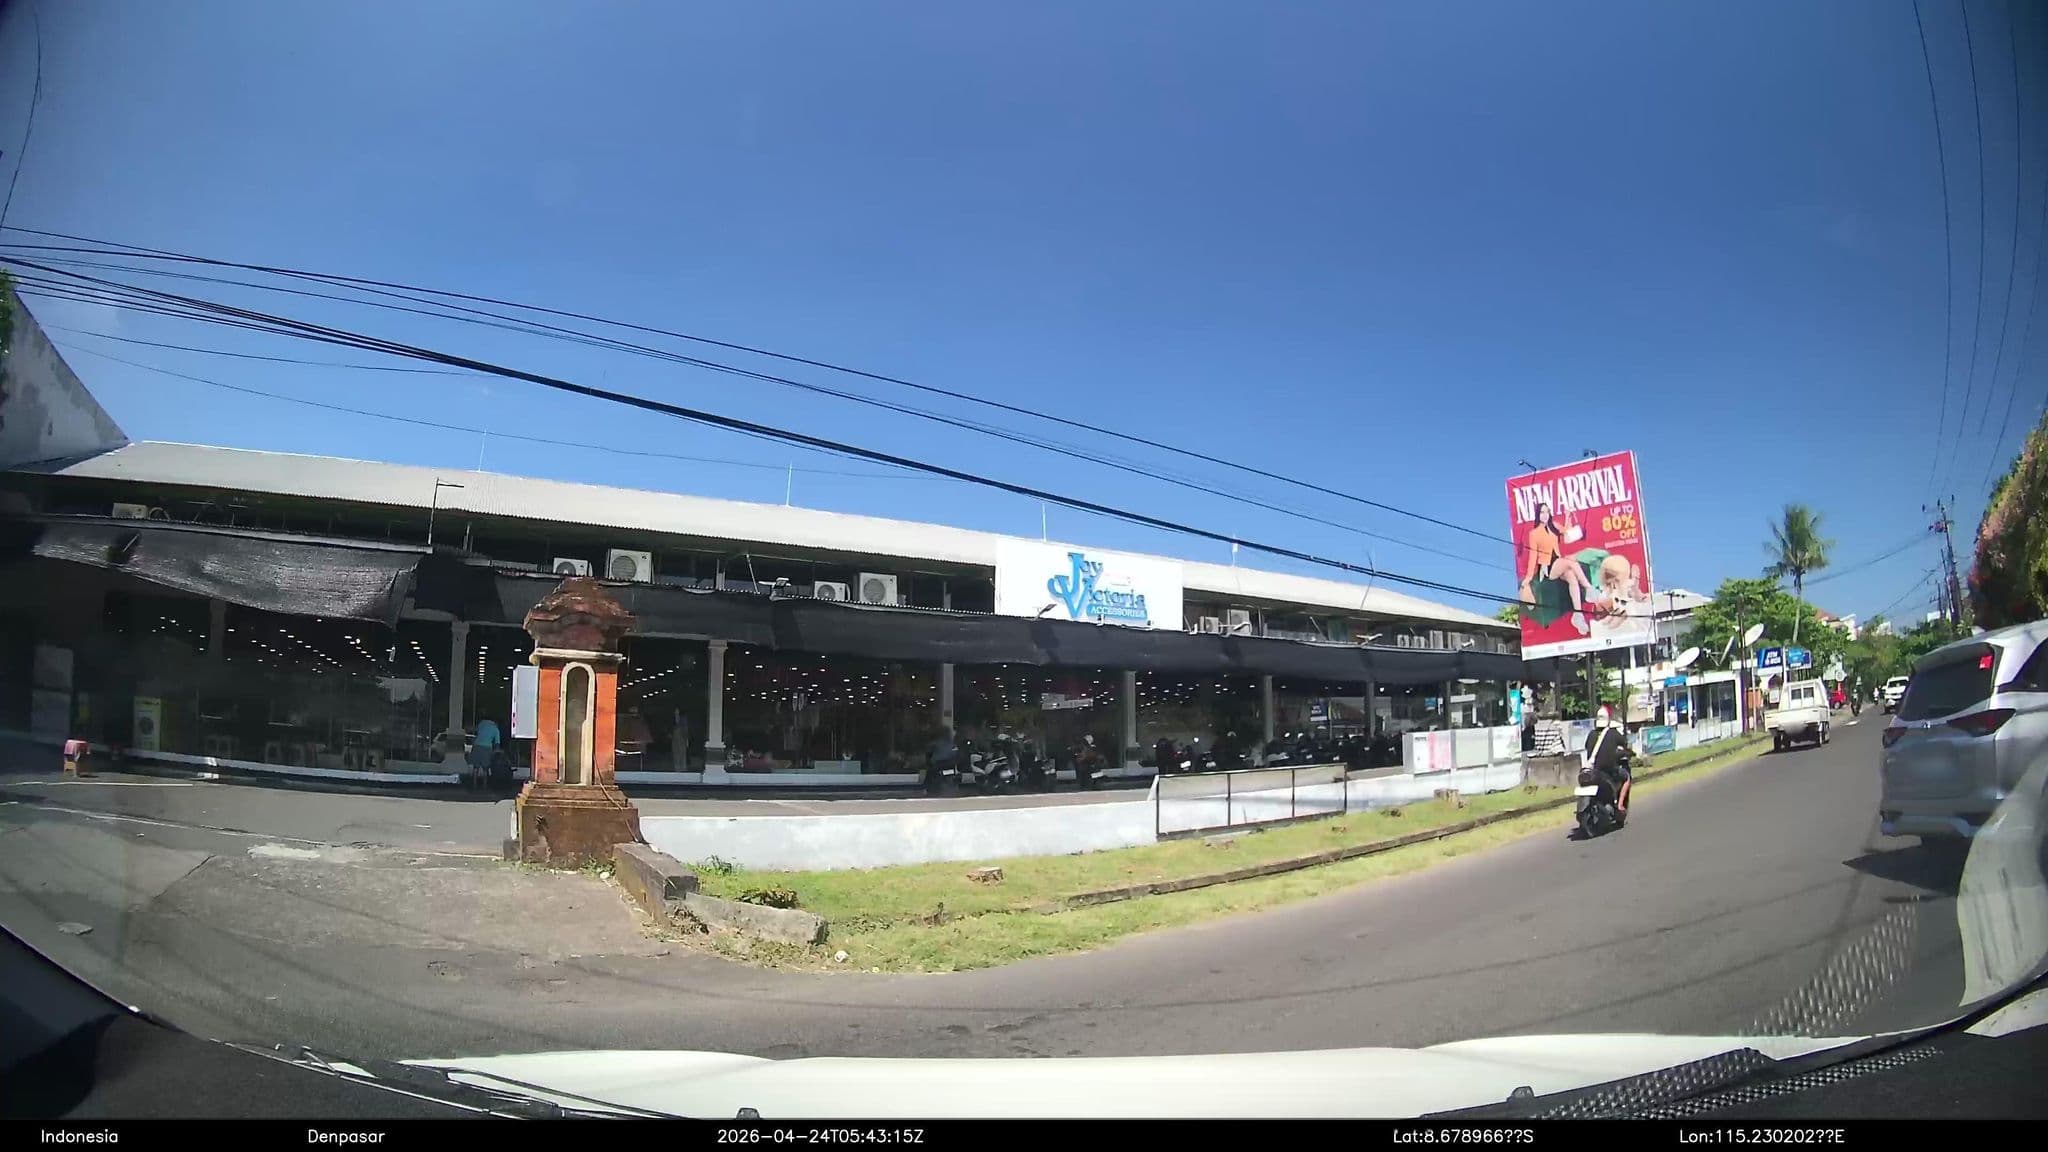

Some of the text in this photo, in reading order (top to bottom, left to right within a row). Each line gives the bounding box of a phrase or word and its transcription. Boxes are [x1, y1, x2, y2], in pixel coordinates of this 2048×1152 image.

[1513, 464, 1632, 524] NEW ARRIVAL
[1610, 504, 1634, 517] UP TO
[1602, 514, 1637, 532] 80%
[1619, 528, 1637, 539] OFF
[1055, 575, 1146, 618] Victoria
[1090, 605, 1145, 617] ACCESSORIES
